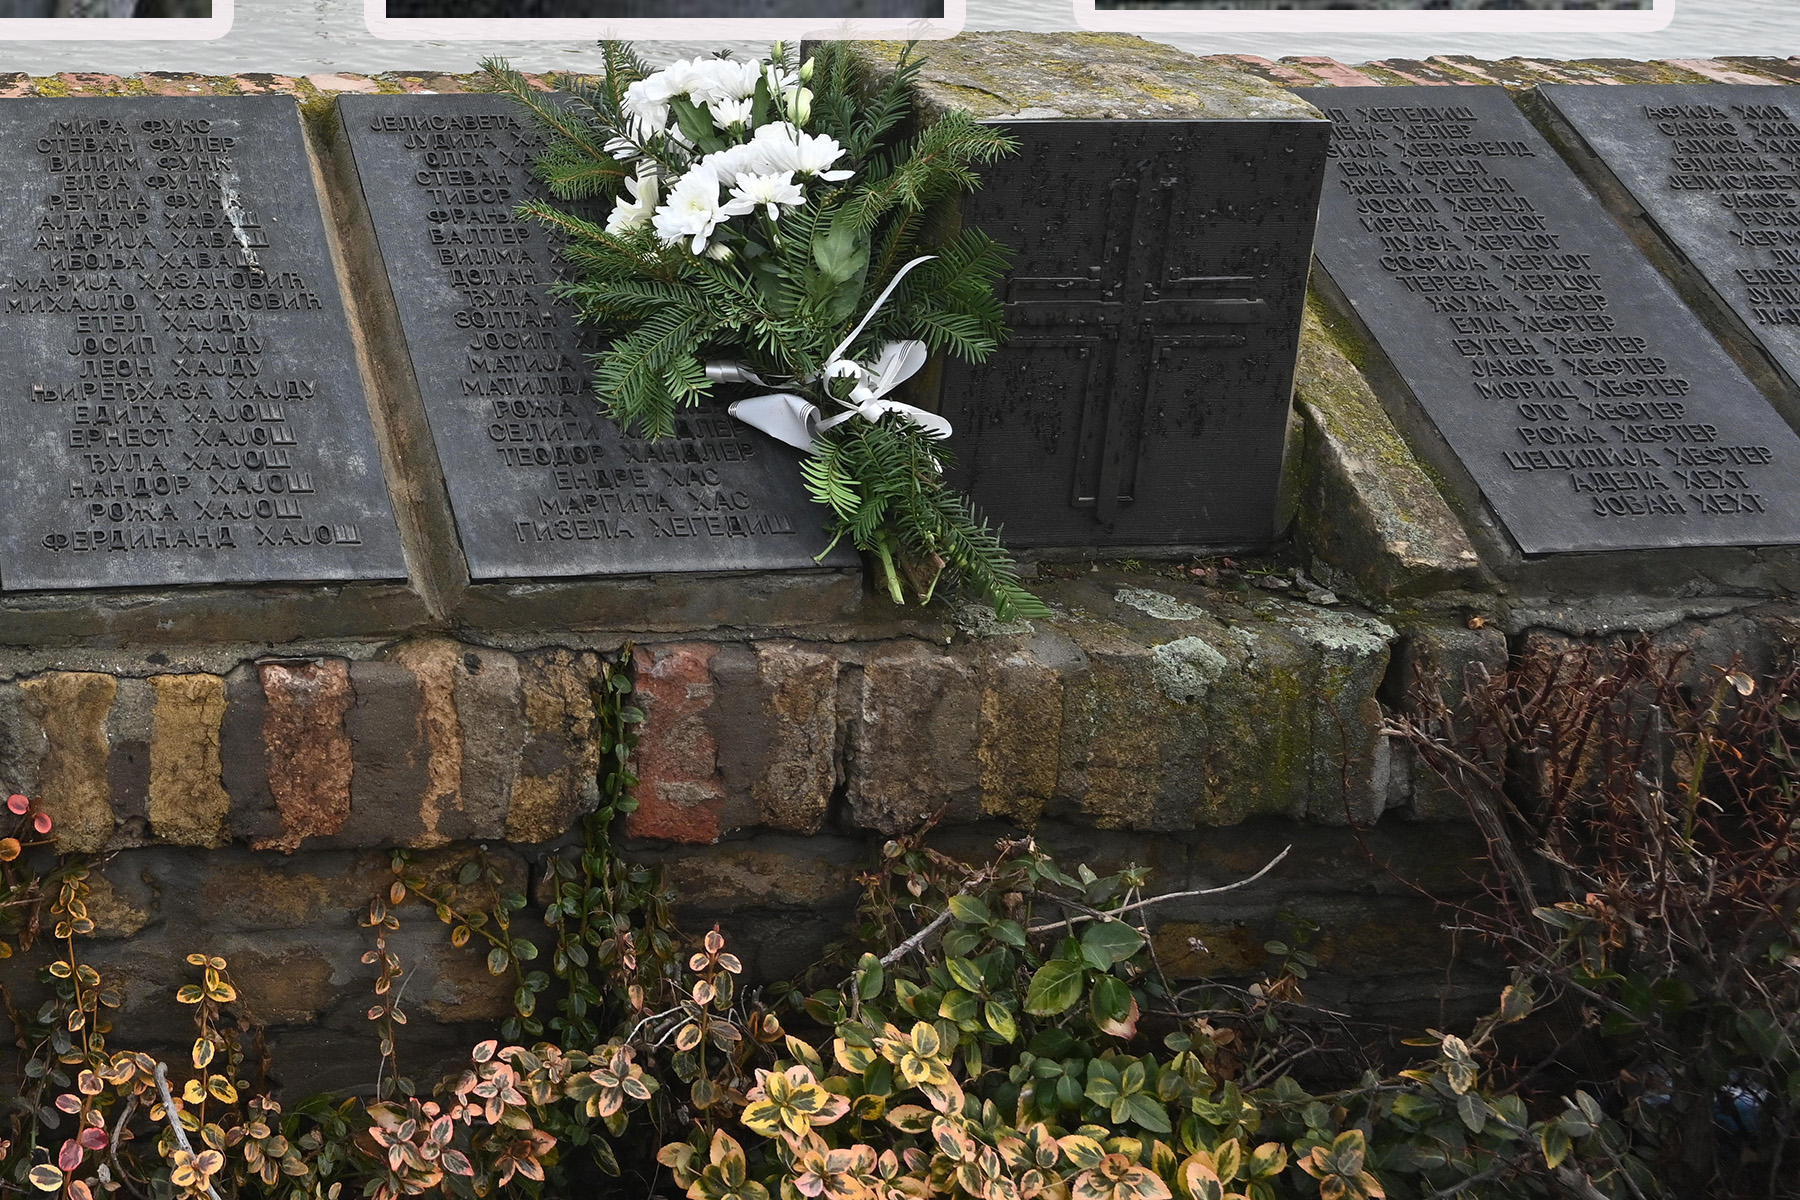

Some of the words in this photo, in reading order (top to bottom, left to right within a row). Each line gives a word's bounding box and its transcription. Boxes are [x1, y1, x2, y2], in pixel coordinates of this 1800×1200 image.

[1357, 107, 1478, 124] ХЕГЕДИШ
[1645, 106, 1728, 120] АФИЈА
[1731, 105, 1789, 119] ХИЛ
[54, 119, 127, 135] МИРА
[140, 119, 211, 134] ФУКС
[370, 115, 521, 132] ЈЕЛИСАВЕТА
[1658, 122, 1738, 137] САНКО
[36, 138, 133, 153] СТЕВАН
[149, 137, 236, 152] ФУЛЕР
[1674, 139, 1756, 154] АЛИСА
[49, 156, 141, 173] ВИЛИМ
[156, 155, 232, 171] ФУНК
[1339, 161, 1397, 177] ЕМА
[1401, 160, 1488, 175] ХЕРЦЛ
[1672, 156, 1777, 171] БЛАНКА
[427, 188, 511, 204] ТИБОР
[1357, 198, 1439, 215] ЈОСИП
[1445, 196, 1535, 213] ХЕРЦЛ
[1359, 215, 1449, 234] ИРЕНА
[1452, 215, 1547, 231] ХЕРЦОГ
[431, 228, 531, 244] ВАЛТЕР
[439, 249, 536, 265] ВИЛМА
[1378, 254, 1488, 273] СОФИЈА
[1493, 254, 1591, 271] ХЕРЦОГ
[12, 274, 122, 292] МАРИЈА
[139, 273, 304, 289] ХАЗАНОВИЋ
[77, 315, 146, 332] ЕТЕЛ
[162, 314, 253, 331] ХАЈДУ
[470, 331, 557, 352] ЈОСИП
[1452, 338, 1537, 357] ЕУГЕН
[1543, 337, 1648, 355] ХЕФТЕР
[1473, 381, 1580, 400] МОРИЦ
[1583, 379, 1691, 398] ХЕФТЕР
[74, 405, 167, 425] ЕДИТА
[184, 404, 285, 422] ХАЈОШ
[1517, 403, 1570, 423] ОТО
[1580, 402, 1688, 420] ХЕФТЕР
[497, 447, 605, 467] ТЕОДОР
[625, 445, 754, 464] ХАНДЛЕР
[69, 477, 191, 498] НАНДОР
[211, 474, 314, 494] ХАЈОШ
[555, 470, 649, 491] ЕНДРЕ
[667, 469, 722, 488] ХАС
[1571, 471, 1666, 492] АДЕЛА
[1672, 469, 1750, 489] ХЕХТ
[88, 502, 179, 523] РОЖА
[196, 500, 303, 520] ХАЈОШ
[539, 494, 676, 516] МАРГИТА
[687, 491, 752, 510] ХАС
[1593, 495, 1686, 517] ЈОВАН
[1691, 493, 1767, 513] ХЕХТ
[42, 528, 236, 550] ФЕРДИНАНД
[257, 525, 361, 546] ХАЈОШ
[513, 519, 634, 542] ГИЗЕЛА
[650, 515, 797, 538] ХЕГЕДИШ
